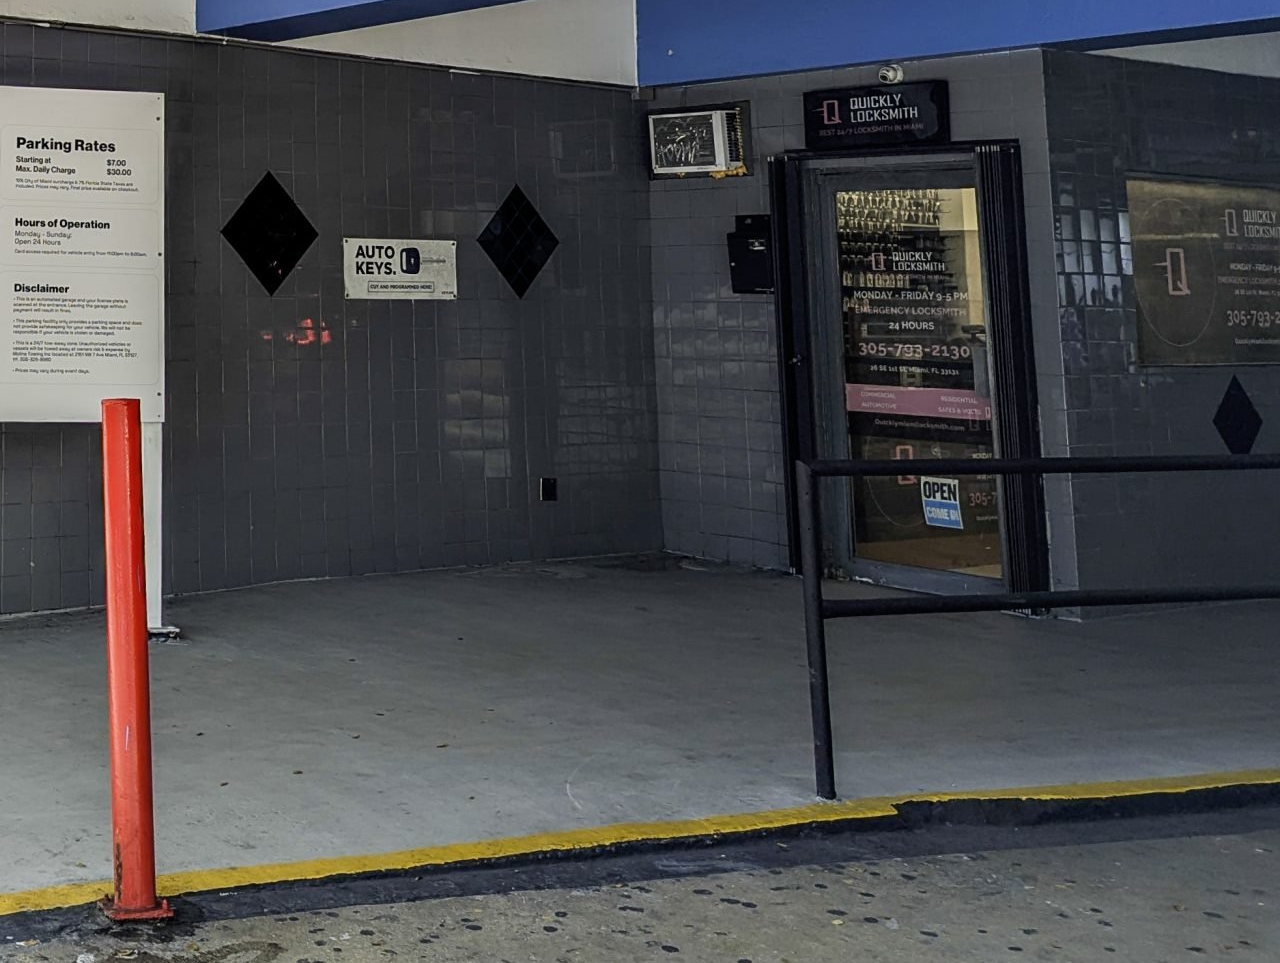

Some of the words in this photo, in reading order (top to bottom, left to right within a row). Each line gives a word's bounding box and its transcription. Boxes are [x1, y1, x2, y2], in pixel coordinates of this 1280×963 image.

[850, 93, 901, 110] QUICKLY
[850, 106, 918, 123] LOCKSMITH
[854, 125, 893, 135] LOCKSMITH
[16, 137, 72, 153] Parking
[74, 139, 116, 152] Rates
[16, 156, 43, 164] Starting
[106, 159, 127, 167] $7.00
[33, 166, 50, 174] Daily
[51, 167, 76, 175] Charge
[106, 168, 132, 176] $30.00
[1243, 209, 1276, 223] QUICKLY
[15, 218, 46, 228] Hours
[47, 219, 58, 228] of
[59, 219, 110, 230] Operation
[14, 230, 41, 239] Monday
[14, 238, 32, 246] Open
[355, 245, 395, 259] AUTO
[892, 252, 932, 261] QUICKLY
[355, 261, 397, 275] KEYS.
[893, 262, 945, 271] LOCKSMITH
[14, 283, 70, 293] Disclaimer
[854, 291, 893, 300] MONDAY
[901, 292, 934, 300] FRIDAY
[936, 293, 952, 302] 9-5
[953, 292, 968, 300] PM
[855, 305, 909, 315] EMERGENCY
[912, 307, 967, 316] LOCKSMITH
[888, 322, 900, 330] 24
[901, 321, 935, 330] HOURS
[858, 342, 970, 360] 305-793-2130
[861, 391, 896, 399] COMMERCIAL
[940, 396, 978, 404] RESIDENTIAL
[861, 402, 897, 410] AUTOMOTIVE
[874, 419, 965, 431] Quicklymiamilocksmith.com
[923, 481, 957, 502] OPEN
[926, 508, 949, 520] COME
[950, 510, 960, 521] IN
